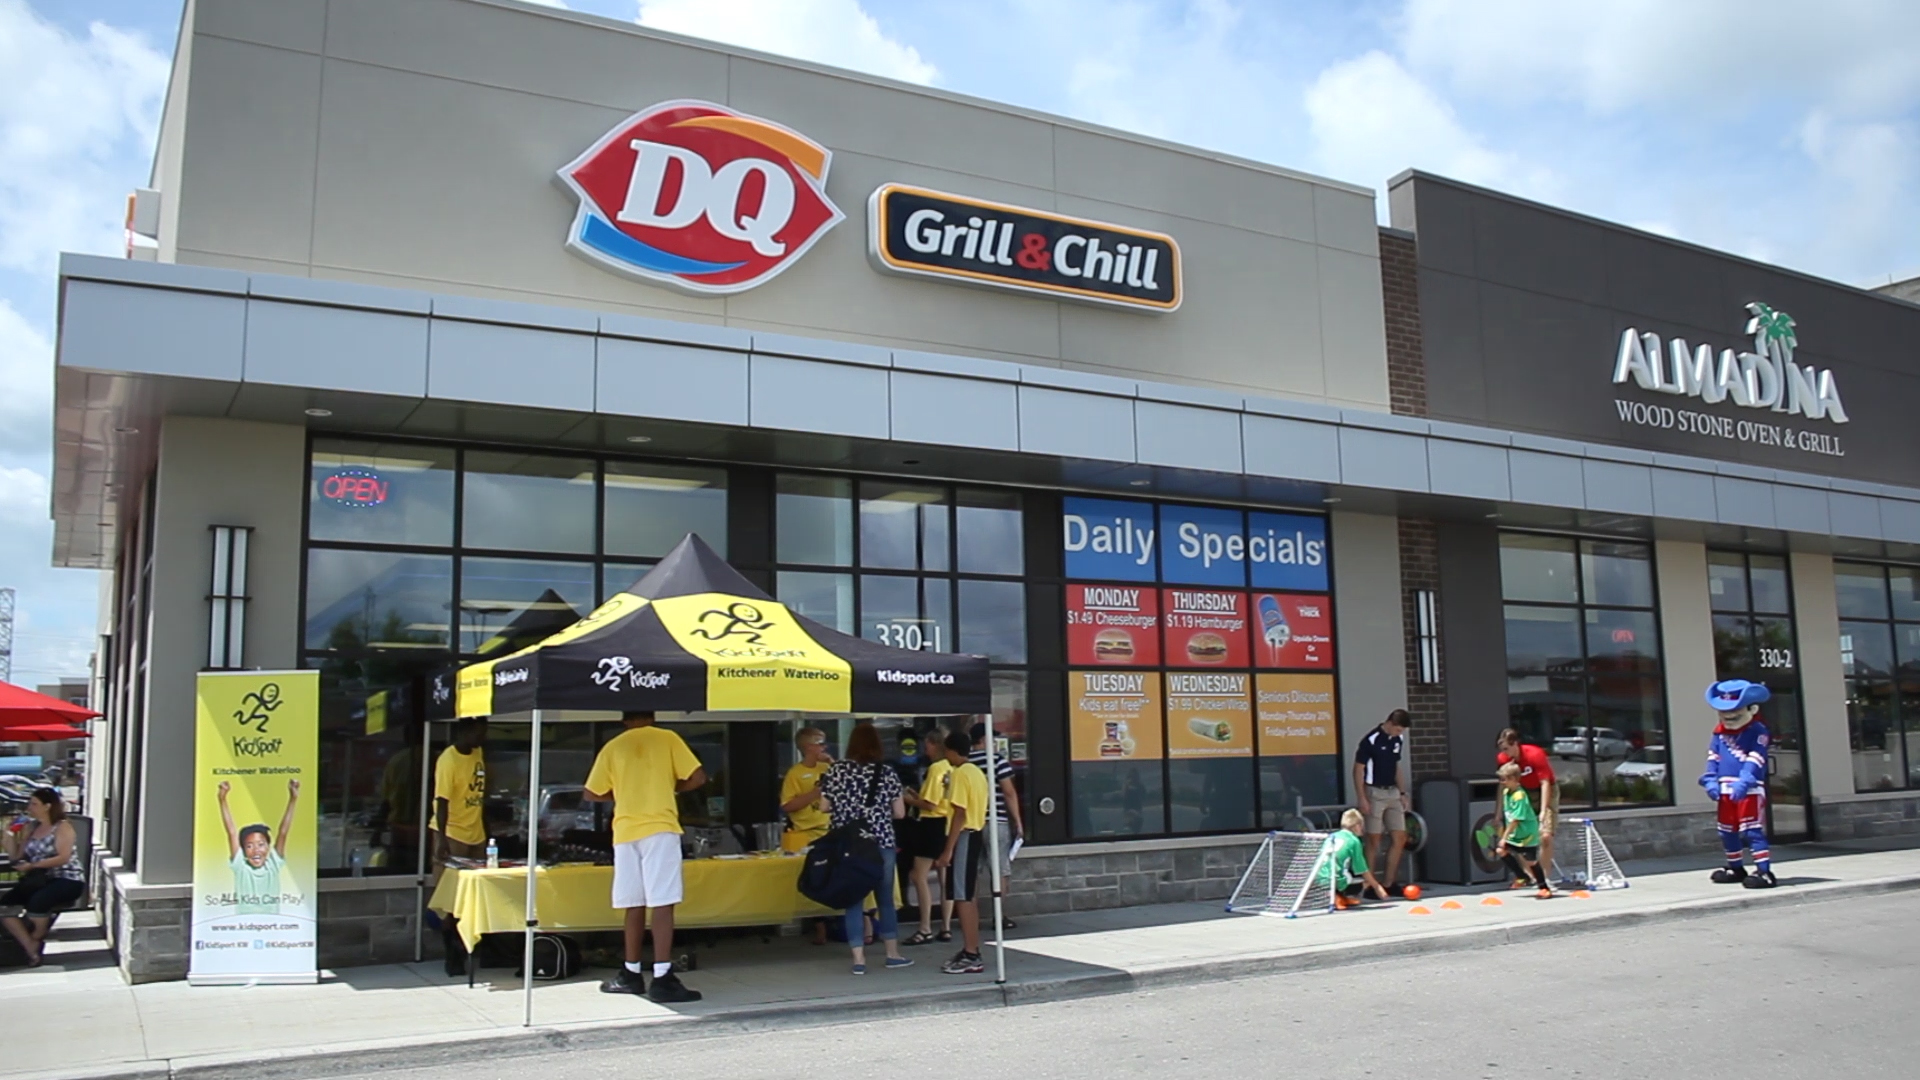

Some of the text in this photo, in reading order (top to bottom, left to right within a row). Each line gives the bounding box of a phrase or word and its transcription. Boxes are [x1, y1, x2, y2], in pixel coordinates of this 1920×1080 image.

[616, 139, 796, 257] DQ
[904, 208, 1160, 291] Grill & Chill
[1613, 322, 1850, 424] ALMADINA
[1614, 399, 1846, 457] WOOD STONE OVEN & GRILL
[323, 475, 389, 502] OPEN
[1064, 514, 1155, 566] Daily
[1084, 587, 1140, 607] MONDAY
[1172, 591, 1237, 611] THURSDAY
[1067, 610, 1157, 630] $1.49 Cheeseburger
[1166, 614, 1244, 632] $1.19 Hamburger
[1759, 648, 1793, 668] 330-2
[717, 667, 840, 681] Kitchener Waterloo
[876, 670, 955, 686] Kidsport.ca
[1084, 674, 1144, 692] TUESDAY
[1170, 675, 1245, 692] WEDNESDAY
[1079, 698, 1101, 711] Kids
[1103, 700, 1118, 711] eat
[1168, 697, 1249, 712] $1.99 Chicken Wrap
[1258, 690, 1290, 703] Seniors
[232, 736, 283, 758] KidSport
[212, 766, 302, 776] Kitchener Waterloo
[205, 894, 218, 906] So
[241, 893, 260, 905] Kids
[262, 894, 281, 905] Can
[211, 922, 300, 932] www.kidsport.com
